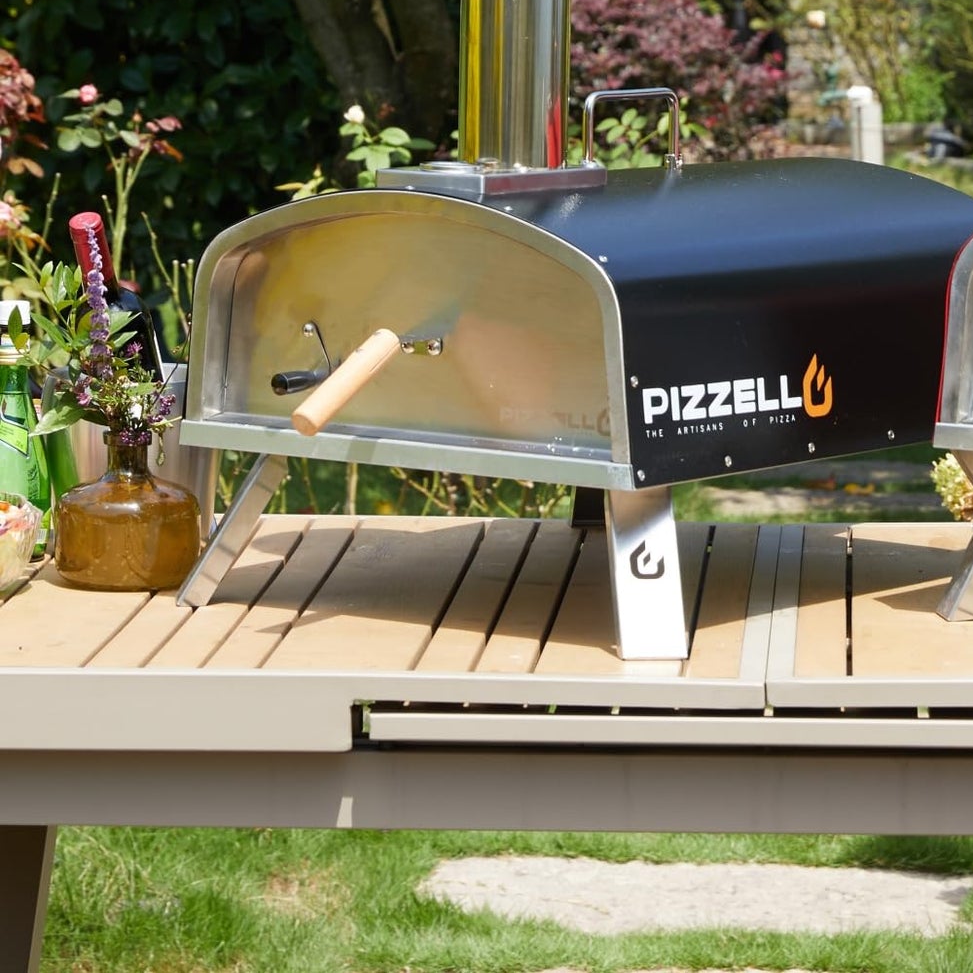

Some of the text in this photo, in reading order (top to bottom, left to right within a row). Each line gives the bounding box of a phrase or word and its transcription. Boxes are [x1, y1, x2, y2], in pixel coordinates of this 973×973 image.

[645, 414, 797, 439] THE ARTISANS OF PIZZA
